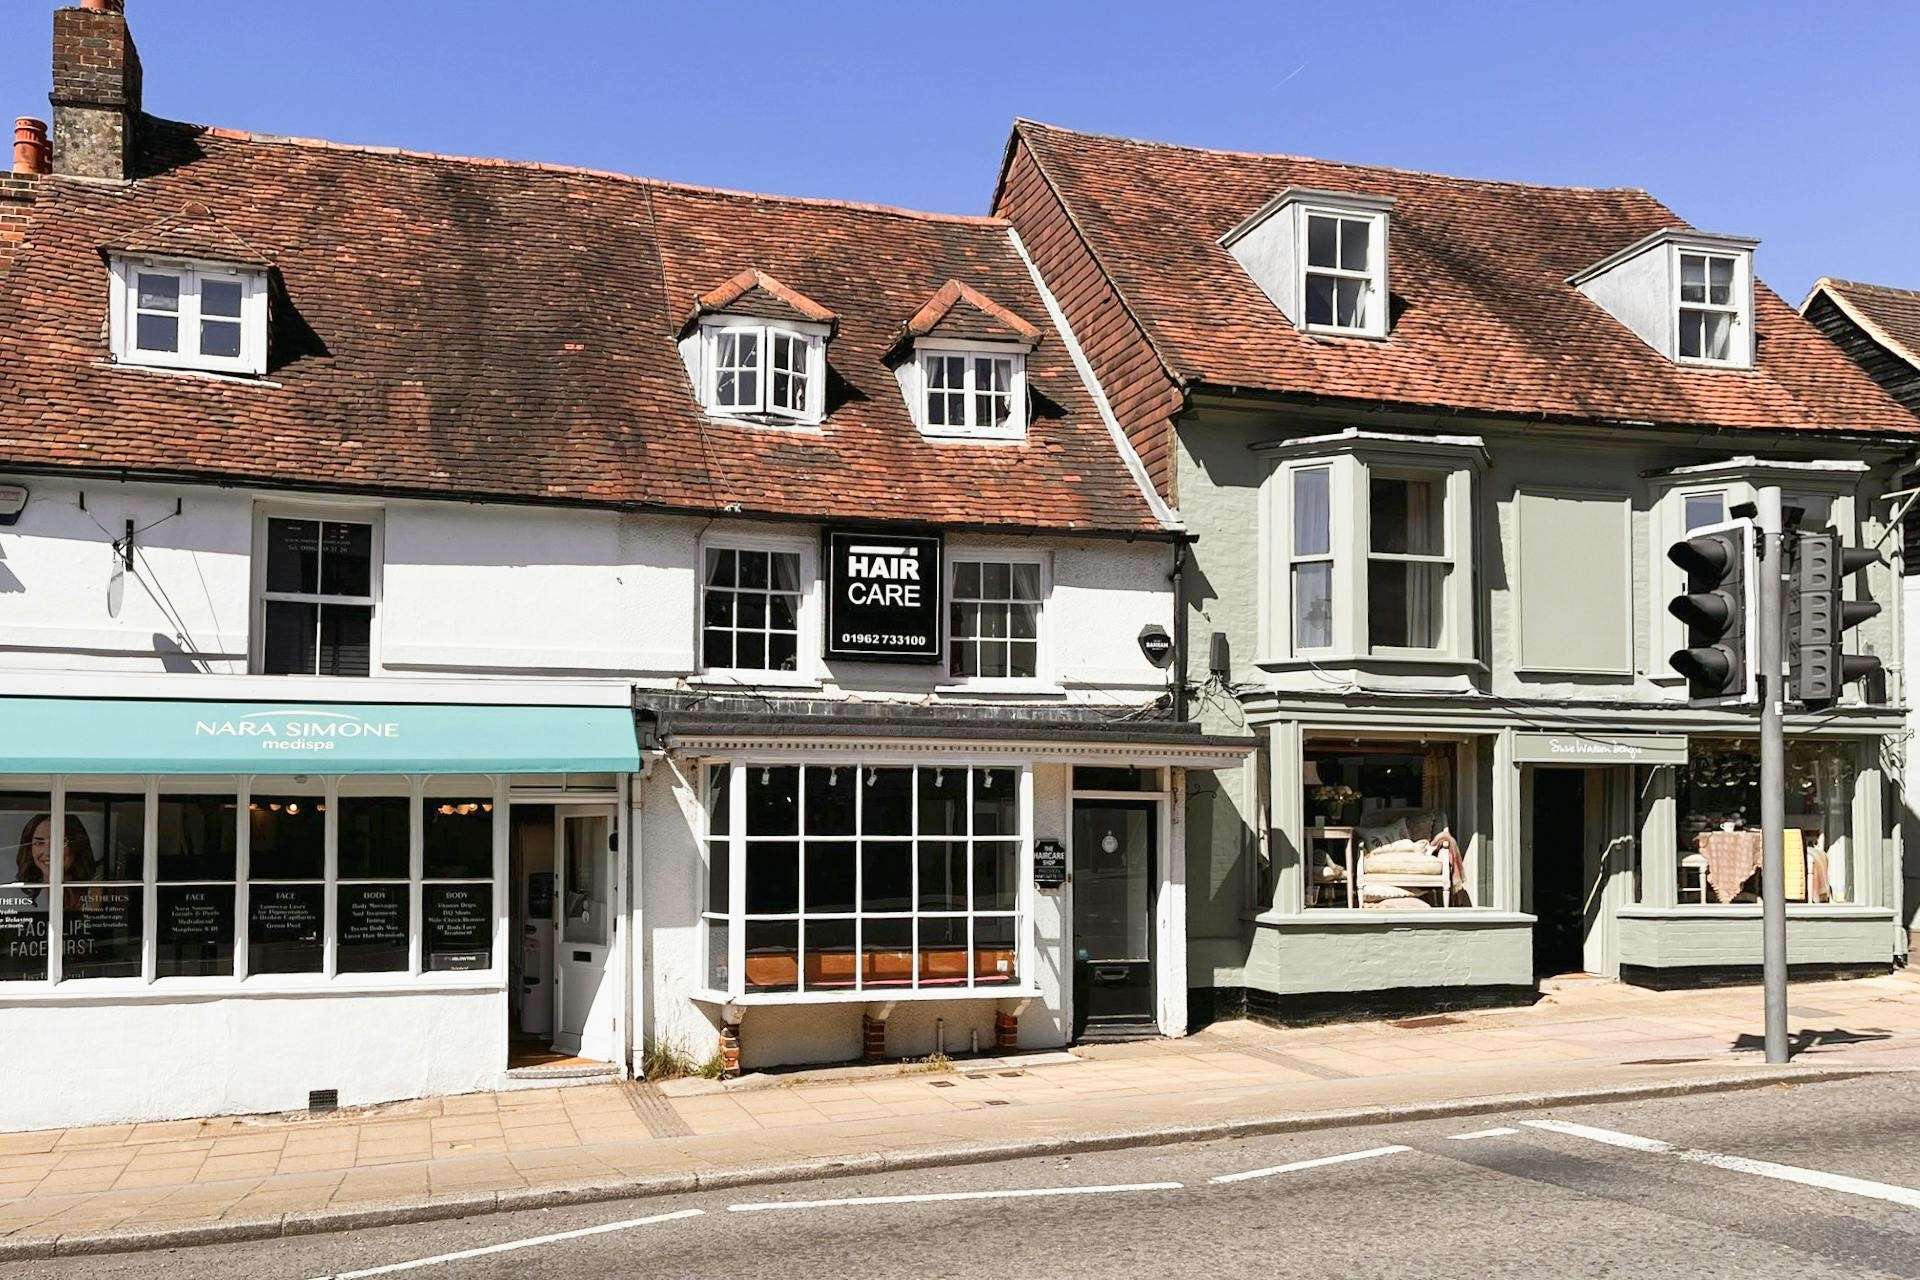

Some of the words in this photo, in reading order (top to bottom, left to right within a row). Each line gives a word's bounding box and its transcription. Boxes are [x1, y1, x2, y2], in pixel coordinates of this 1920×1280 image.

[848, 555, 921, 581] HAIR
[847, 582, 921, 607] CARE
[842, 633, 880, 645] 01962
[881, 634, 926, 646] 733100
[195, 720, 277, 737] NARA
[286, 721, 400, 738] SIMONE
[262, 738, 335, 751] medispa
[1033, 852, 1065, 860] HAIRCARE
